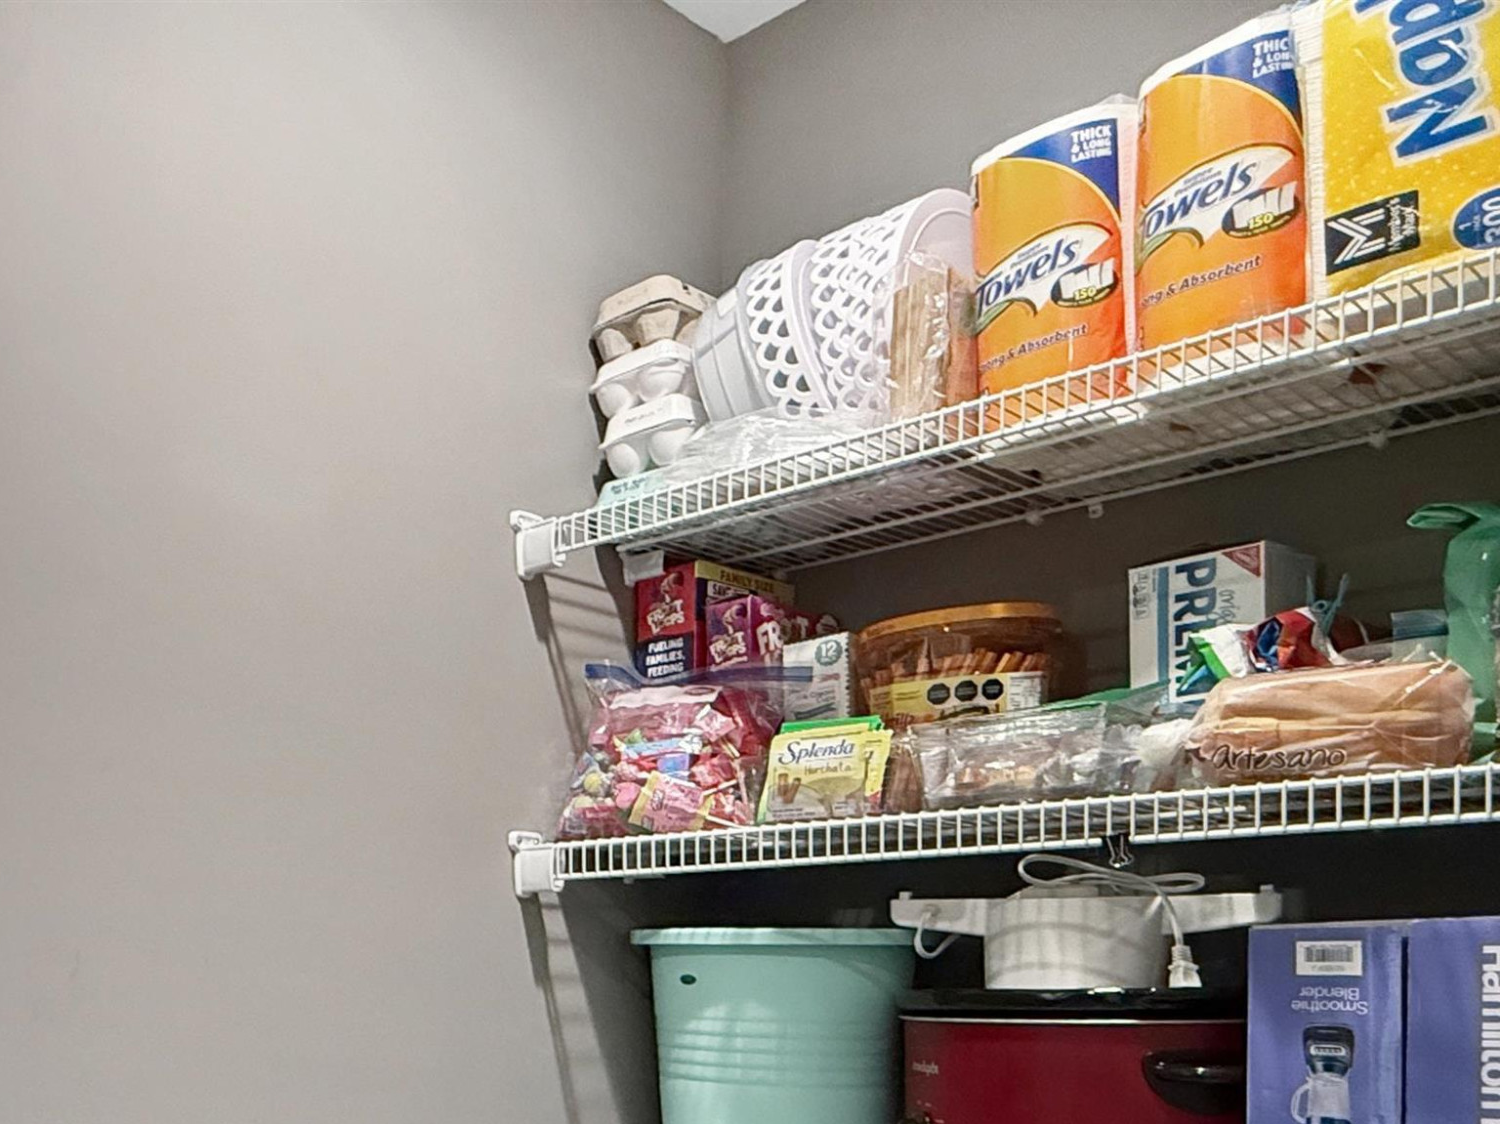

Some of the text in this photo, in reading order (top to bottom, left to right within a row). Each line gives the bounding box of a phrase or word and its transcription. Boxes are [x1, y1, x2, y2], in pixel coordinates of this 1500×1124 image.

[1252, 37, 1290, 56] THIC
[1266, 52, 1290, 63] LON
[1071, 125, 1112, 145] THICK
[1083, 137, 1111, 151] LONG
[1248, 212, 1274, 229] 150
[976, 238, 1078, 316] Towels
[1179, 255, 1262, 291] Absorbent
[1073, 287, 1097, 301] 150
[1017, 323, 1088, 356] Absorbent
[648, 637, 684, 654] FUELING
[820, 641, 838, 657] 12
[778, 739, 856, 766] Splenda
[1211, 744, 1347, 771] Artesano
[1299, 986, 1361, 1001] Blender
[1290, 1000, 1369, 1016] Smoothie
